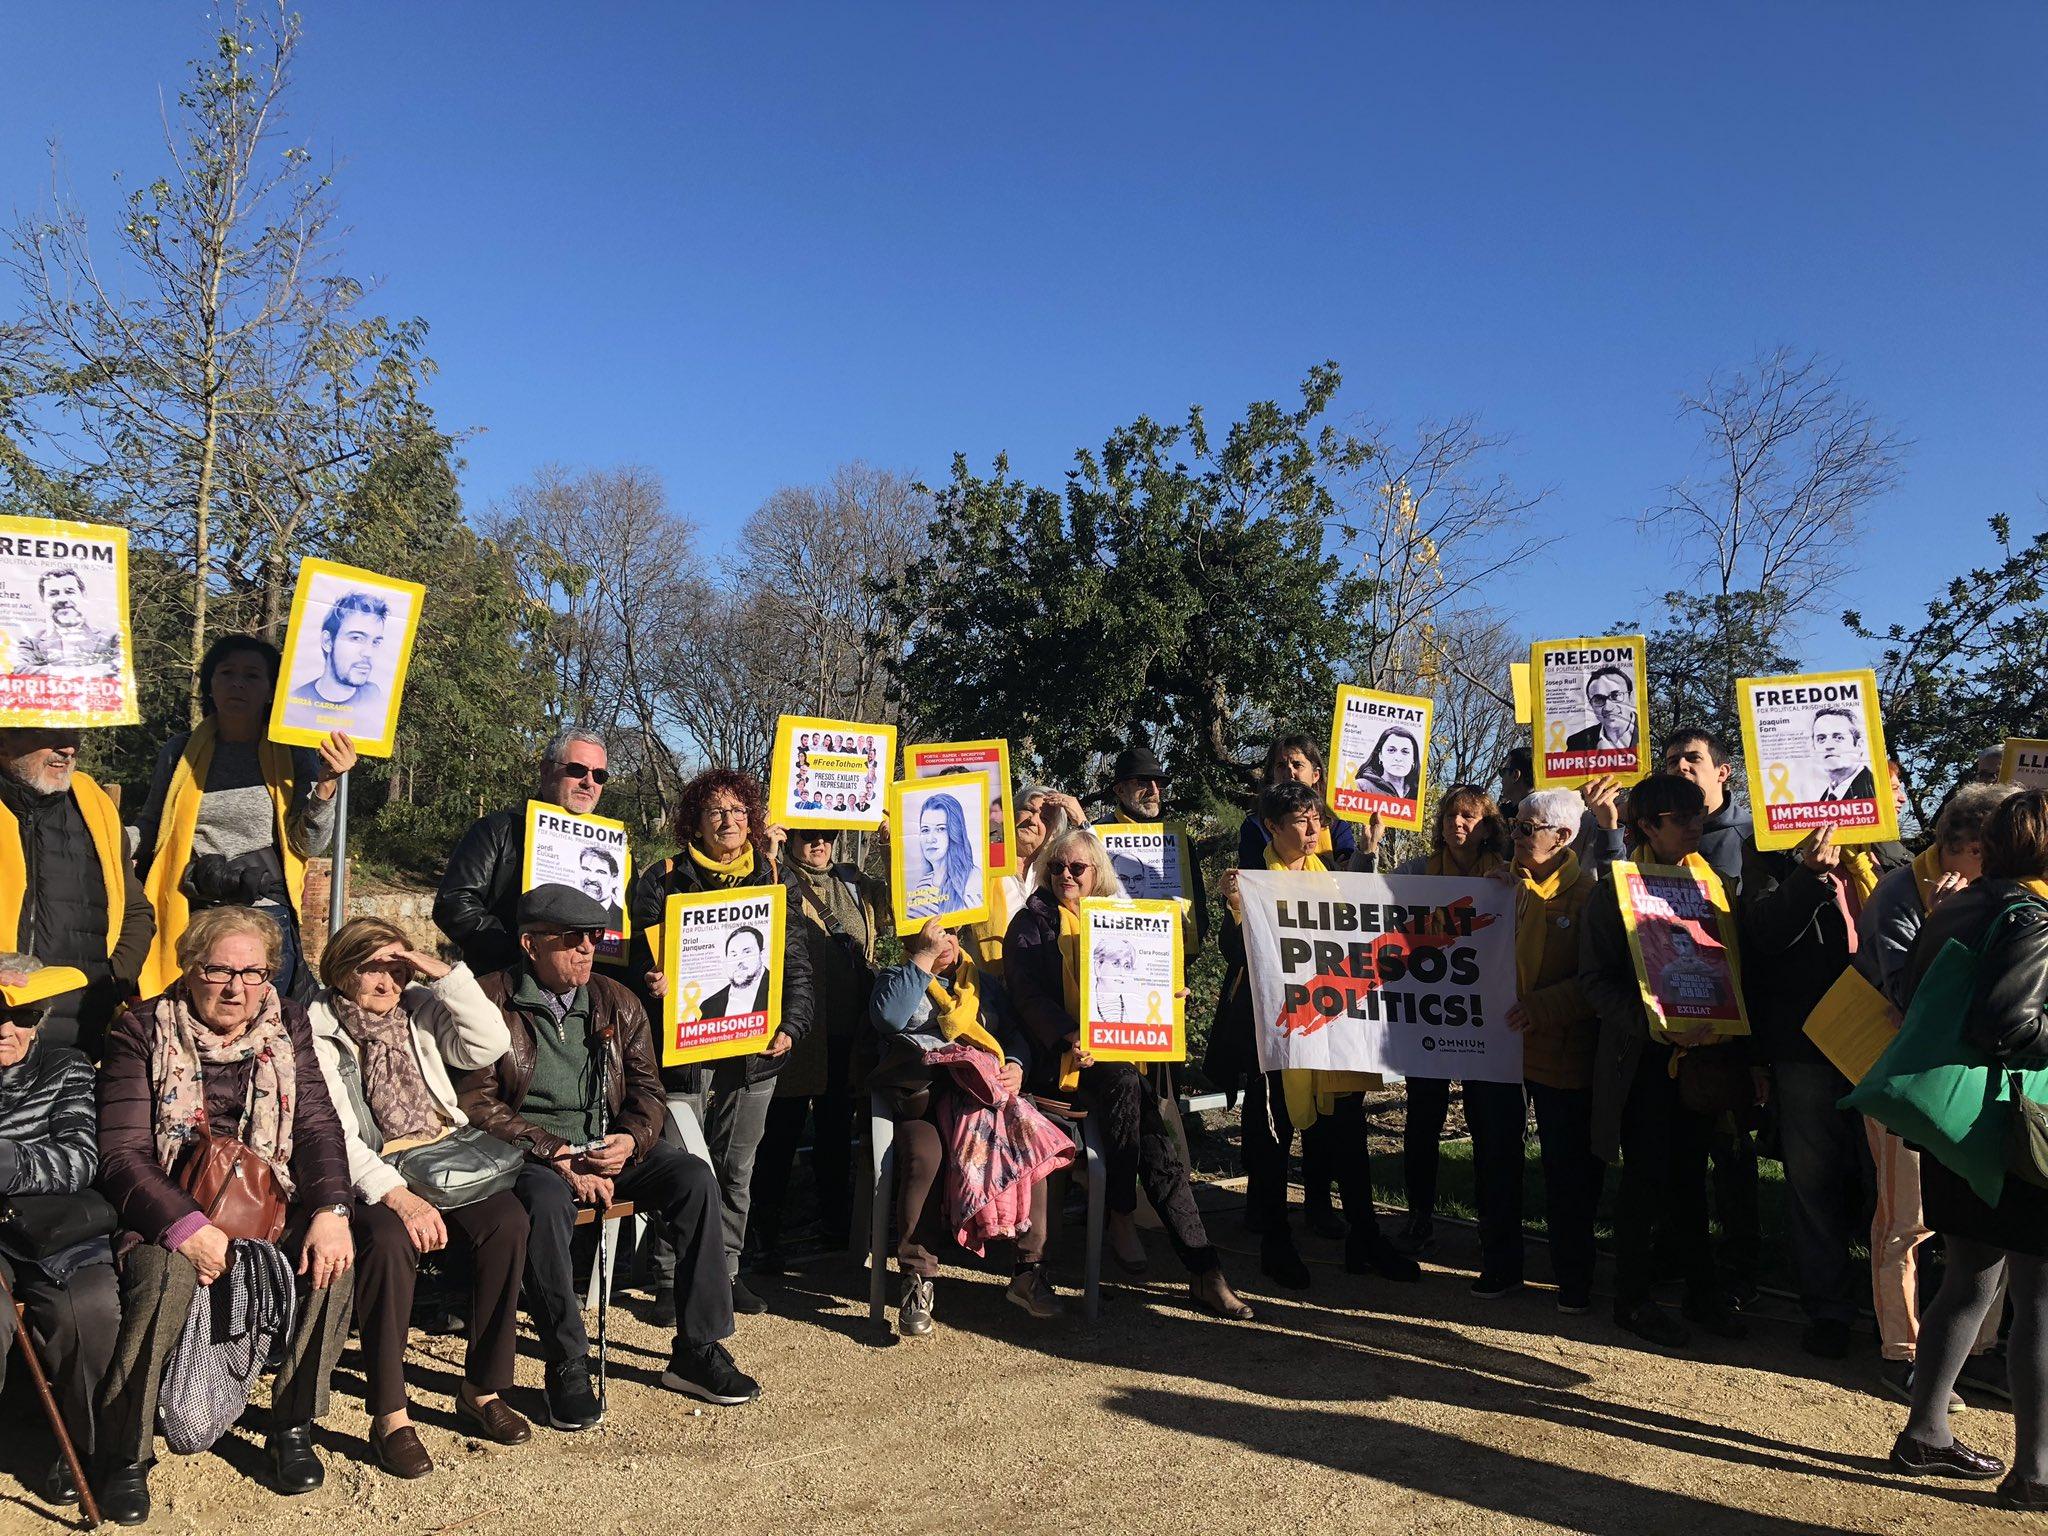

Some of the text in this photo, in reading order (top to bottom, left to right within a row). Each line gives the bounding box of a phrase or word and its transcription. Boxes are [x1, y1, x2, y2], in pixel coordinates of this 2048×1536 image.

[0, 537, 113, 563] REEDOM
[0, 591, 20, 600] chez
[1544, 648, 1632, 667] FREEDOM
[0, 677, 115, 696] MPRISONED
[1755, 684, 1859, 707] FREEDOM
[1347, 700, 1424, 722] LLIBERTAT
[1759, 718, 1790, 726] Joaquim
[812, 758, 863, 769] #FreeTothom
[1548, 754, 1637, 771] IMPRISONED
[820, 780, 858, 790] REPRESALIATS
[837, 774, 860, 783] EXILIATS
[1336, 794, 1412, 818] EXILIADA
[1771, 802, 1874, 821] IMPRISONED
[538, 814, 623, 846] FREEDOM
[1773, 816, 1876, 830] since November 2nd 2017
[537, 843, 553, 852] Jordi
[1105, 835, 1176, 848] FREEDOM
[683, 903, 770, 927] FREEDOM
[1093, 914, 1170, 933] LLIBERTAT
[1276, 899, 1477, 937] LLIBERTAT
[694, 925, 720, 933] POLITICAL
[682, 937, 699, 945] Oriol
[682, 943, 715, 952] Junqueras
[1279, 936, 1480, 986] PRESOS
[1284, 980, 1485, 1028] POLÍTICS!
[1676, 1005, 1712, 1015] EXILIAT
[680, 1015, 765, 1039] IMPRISONED
[680, 1039, 698, 1048] since
[699, 1033, 735, 1044] November
[749, 1027, 765, 1037] 2017
[1093, 1029, 1169, 1046] EXILIADA
